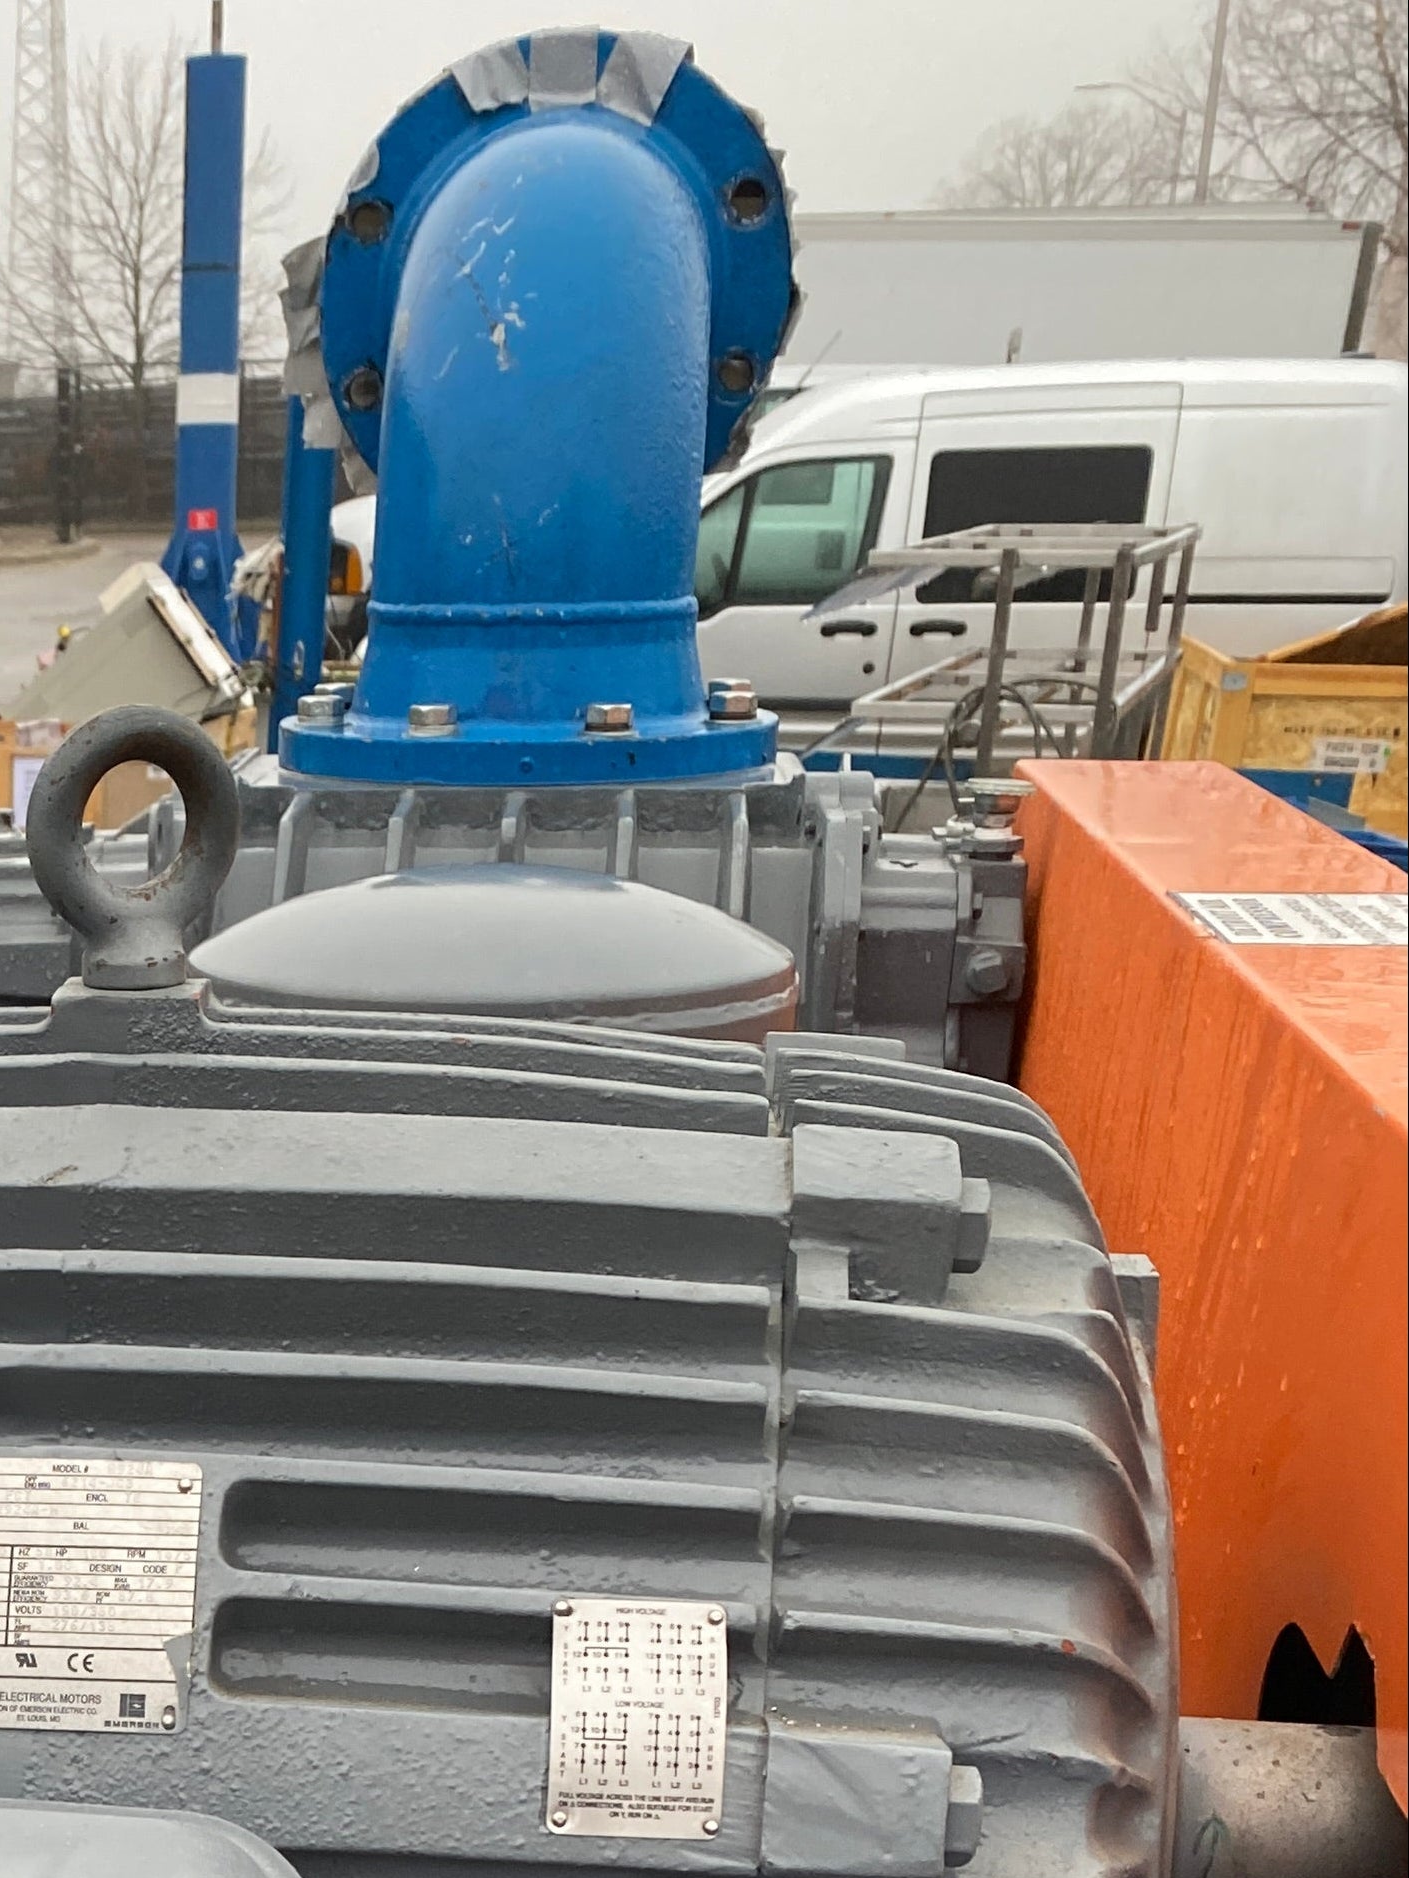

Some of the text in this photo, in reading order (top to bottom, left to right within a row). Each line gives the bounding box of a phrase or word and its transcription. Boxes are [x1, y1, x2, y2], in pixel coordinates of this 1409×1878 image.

[53, 1465, 80, 1473] MODEL
[86, 1493, 108, 1502] ENCL
[73, 1522, 90, 1530] BAL
[18, 1548, 31, 1556] HZ
[127, 1550, 146, 1558] RPM
[17, 1563, 168, 1574] SF DESIGN CODE
[15, 1606, 42, 1614] VOLTS
[0, 1692, 56, 1702] ELECTRICAL
[59, 1694, 102, 1703] MOTORS
